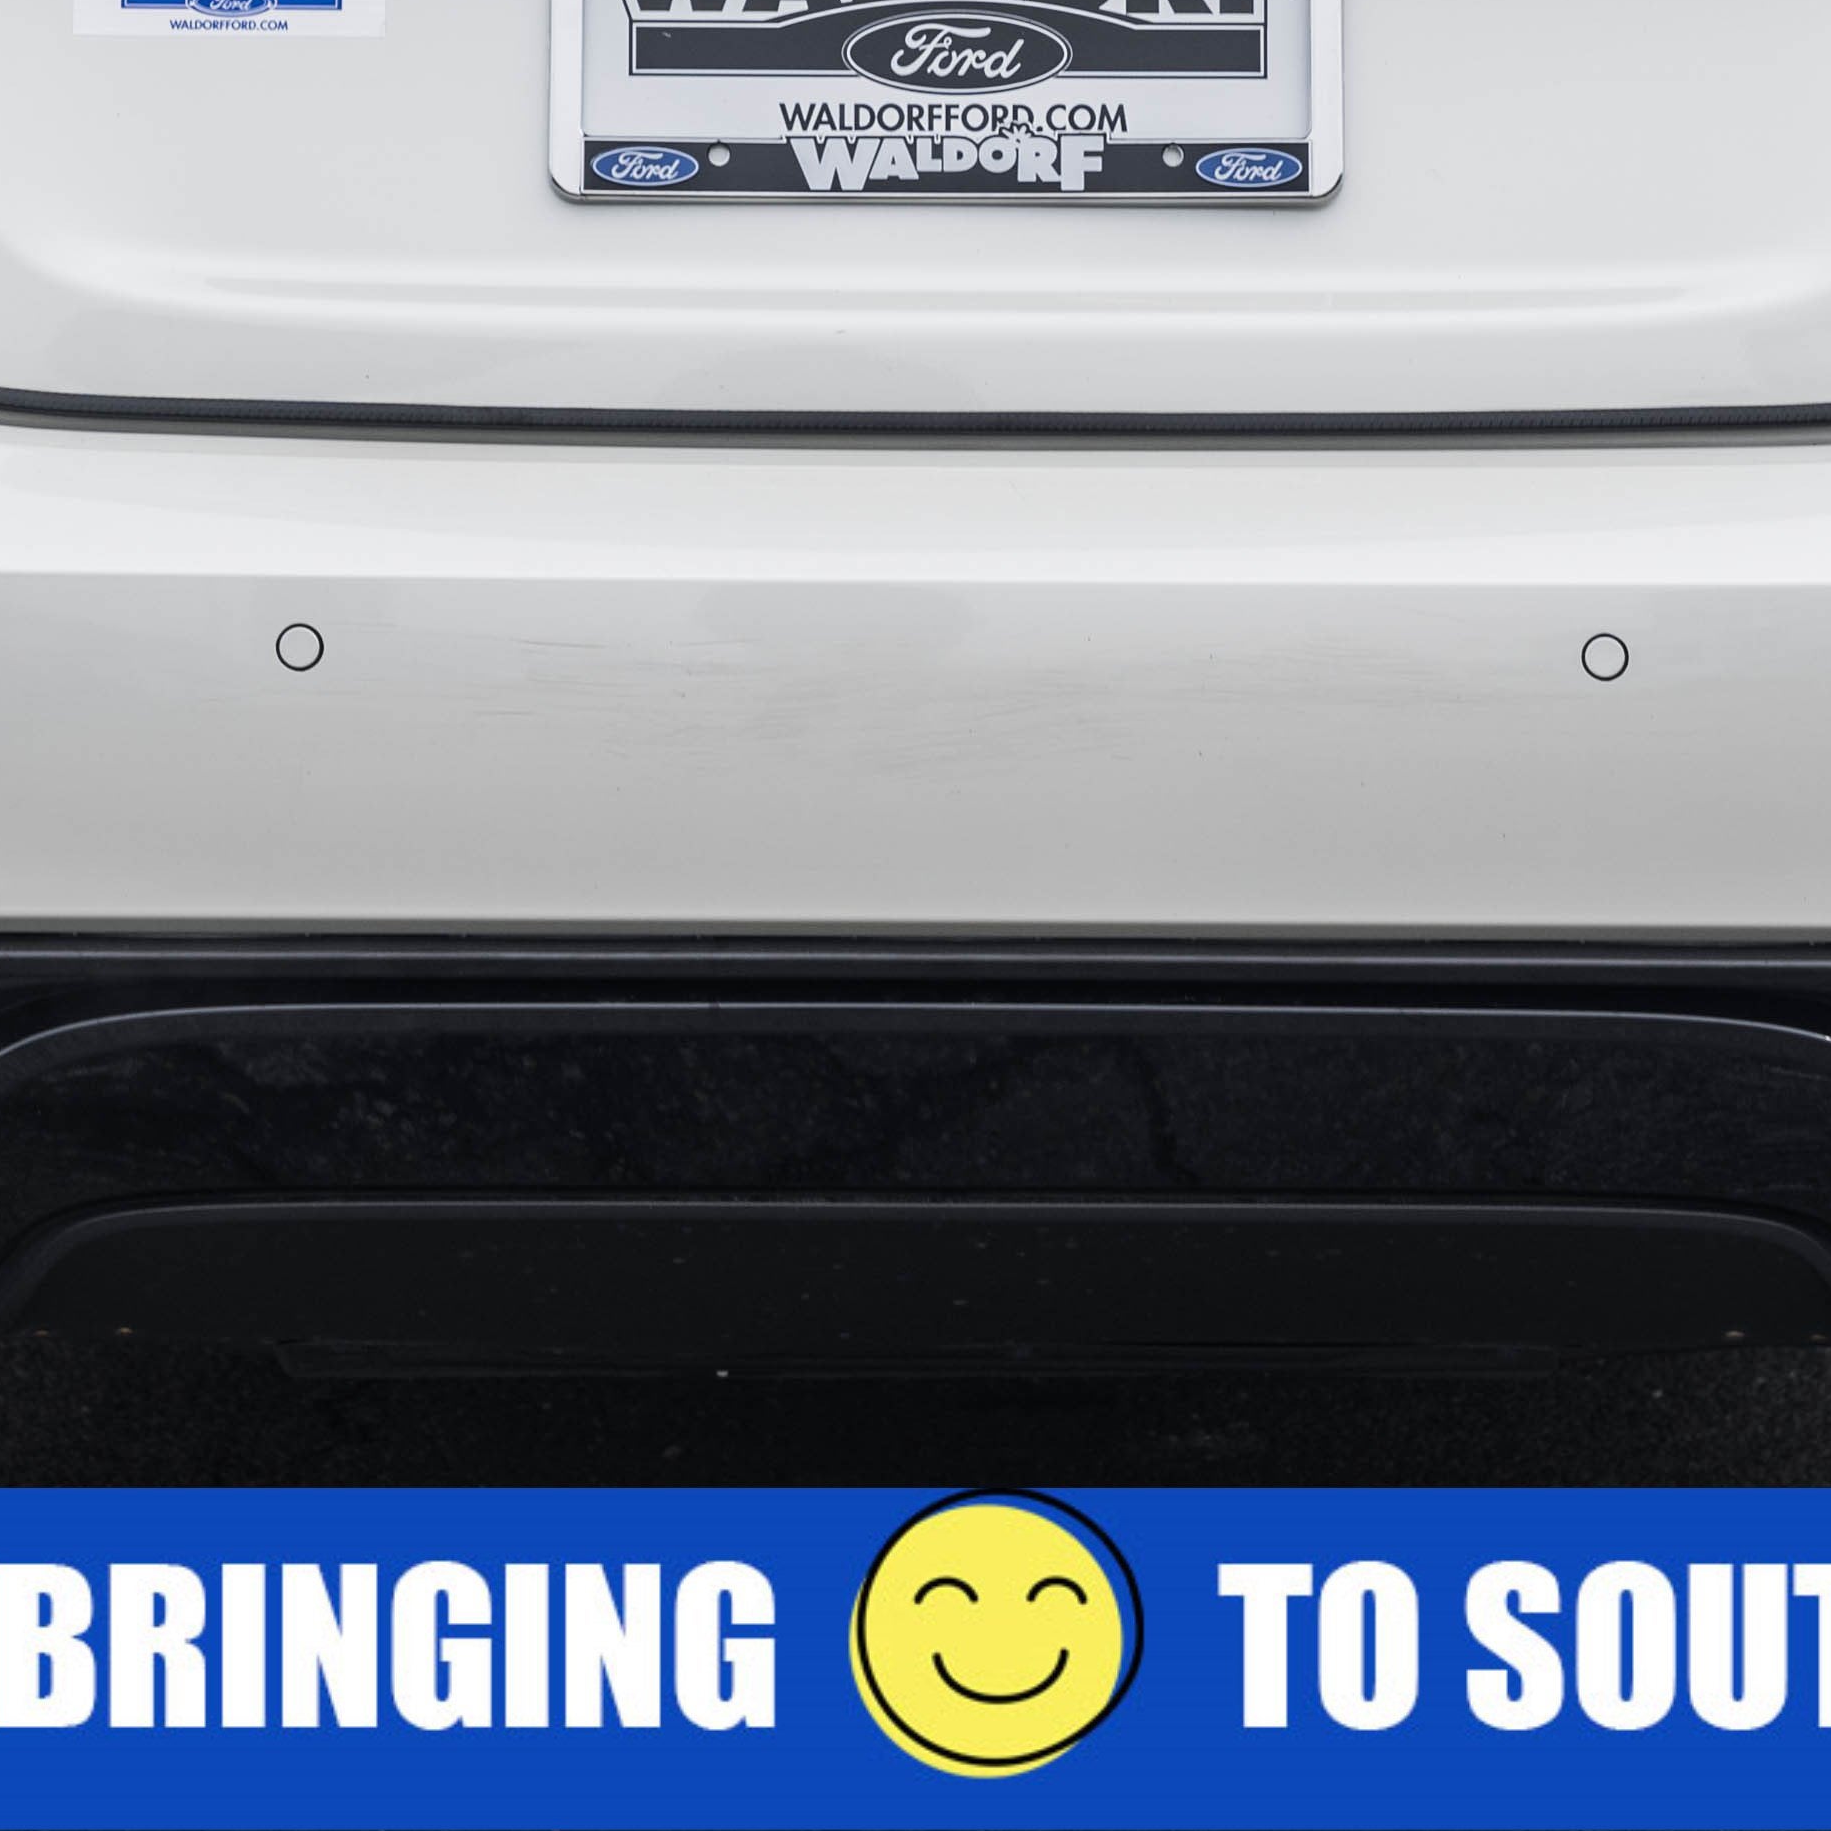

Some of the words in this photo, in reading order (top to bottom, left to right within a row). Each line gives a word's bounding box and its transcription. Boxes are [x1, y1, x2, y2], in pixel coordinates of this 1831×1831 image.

[169, 19, 289, 32] WALDORFFORD.COM
[890, 23, 1022, 80] Ford
[778, 103, 1128, 134] WALDORFFORD.COM
[611, 152, 679, 181] Ford
[789, 136, 1105, 192] WALDORF
[1214, 154, 1283, 182] Ford
